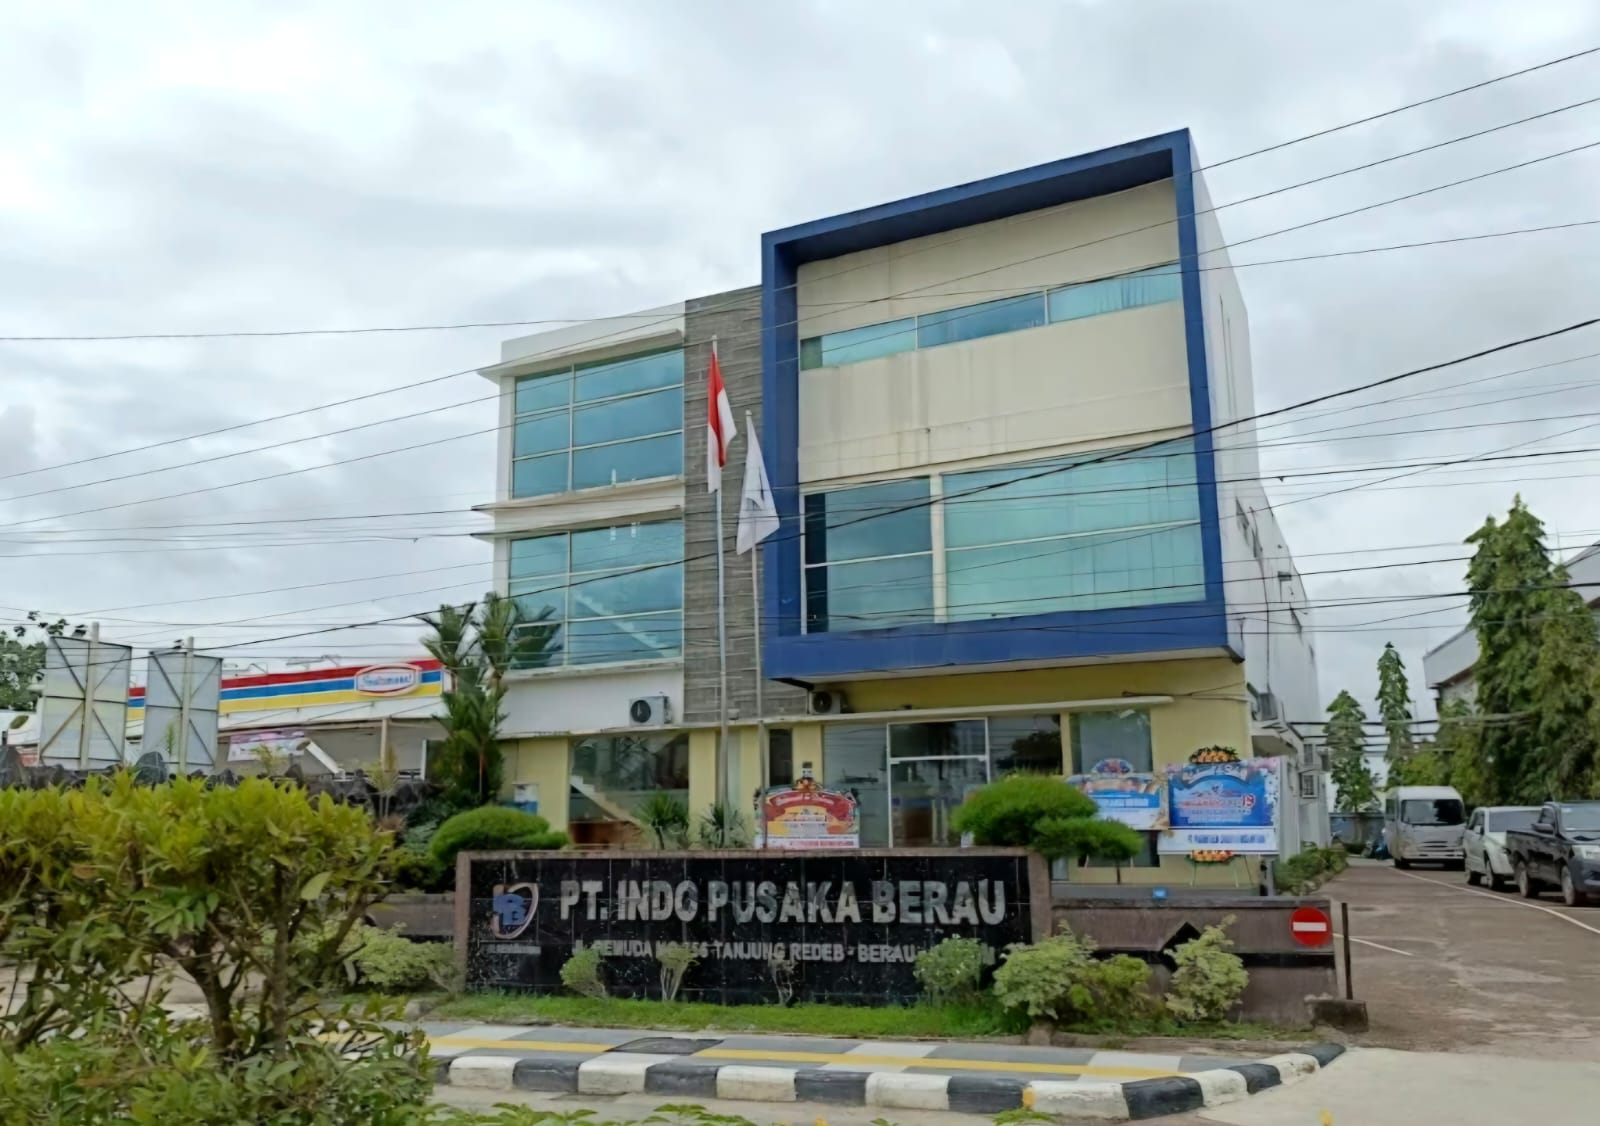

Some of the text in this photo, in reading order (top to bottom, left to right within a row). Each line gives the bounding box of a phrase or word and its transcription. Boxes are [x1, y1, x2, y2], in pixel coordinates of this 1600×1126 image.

[560, 880, 1006, 925] PT. INDO PUSAKA BERAU
[789, 942, 845, 962] REDEB
